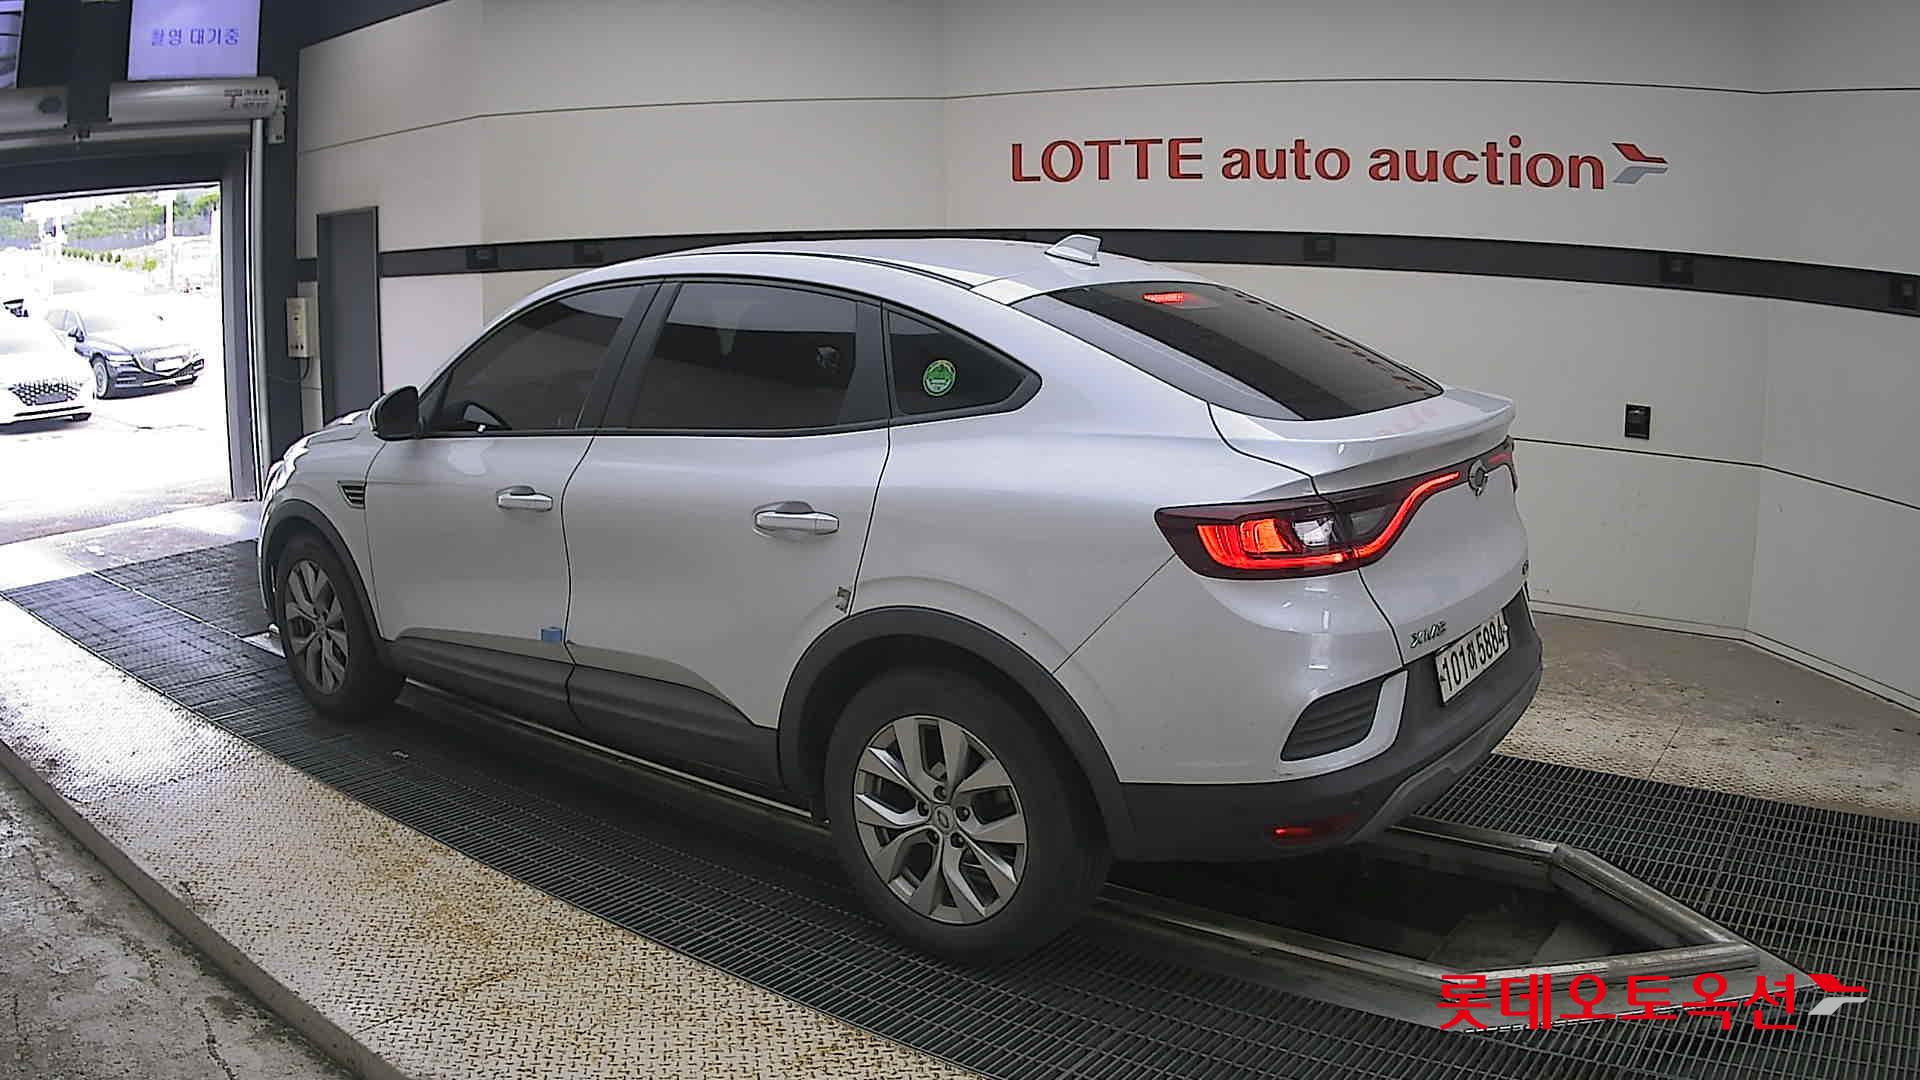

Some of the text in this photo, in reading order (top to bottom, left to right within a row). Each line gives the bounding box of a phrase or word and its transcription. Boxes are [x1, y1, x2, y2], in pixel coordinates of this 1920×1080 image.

[190, 27, 240, 46] 대기중
[1011, 135, 1604, 190] LOTTE auto auction
